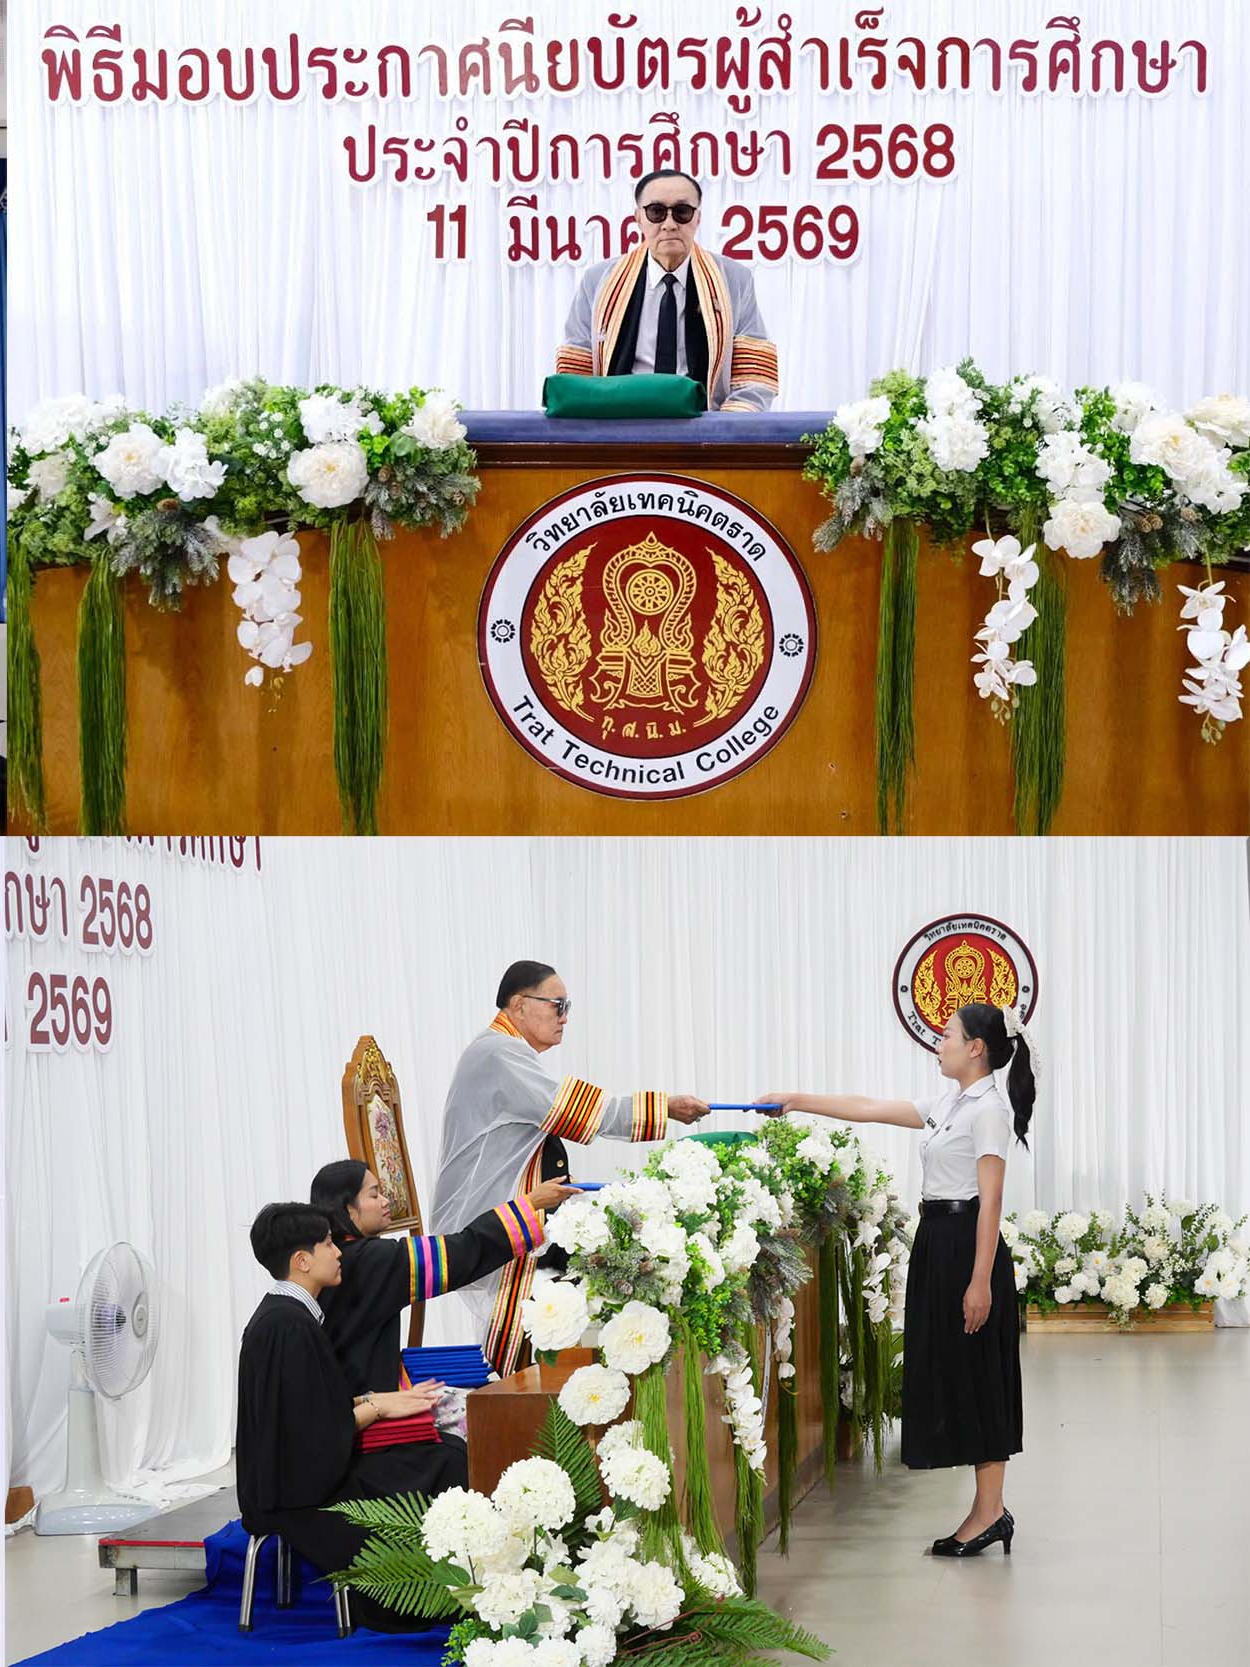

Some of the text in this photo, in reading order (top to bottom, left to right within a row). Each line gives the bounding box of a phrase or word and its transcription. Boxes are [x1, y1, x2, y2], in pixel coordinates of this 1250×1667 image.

[41, 7, 1208, 113] พิธีมอบประกาศนียบัตรผู้สำเร็จการศึกษา
[343, 112, 955, 183] ประจำปีการศึกษา 2568
[427, 195, 860, 261] 11 มีนาค 2569
[525, 490, 767, 562] วิทยาลัยเทคนิคตราด
[513, 696, 780, 785] Trat Technical College
[80, 875, 153, 949] 2568
[28, 971, 112, 1045] 2569
